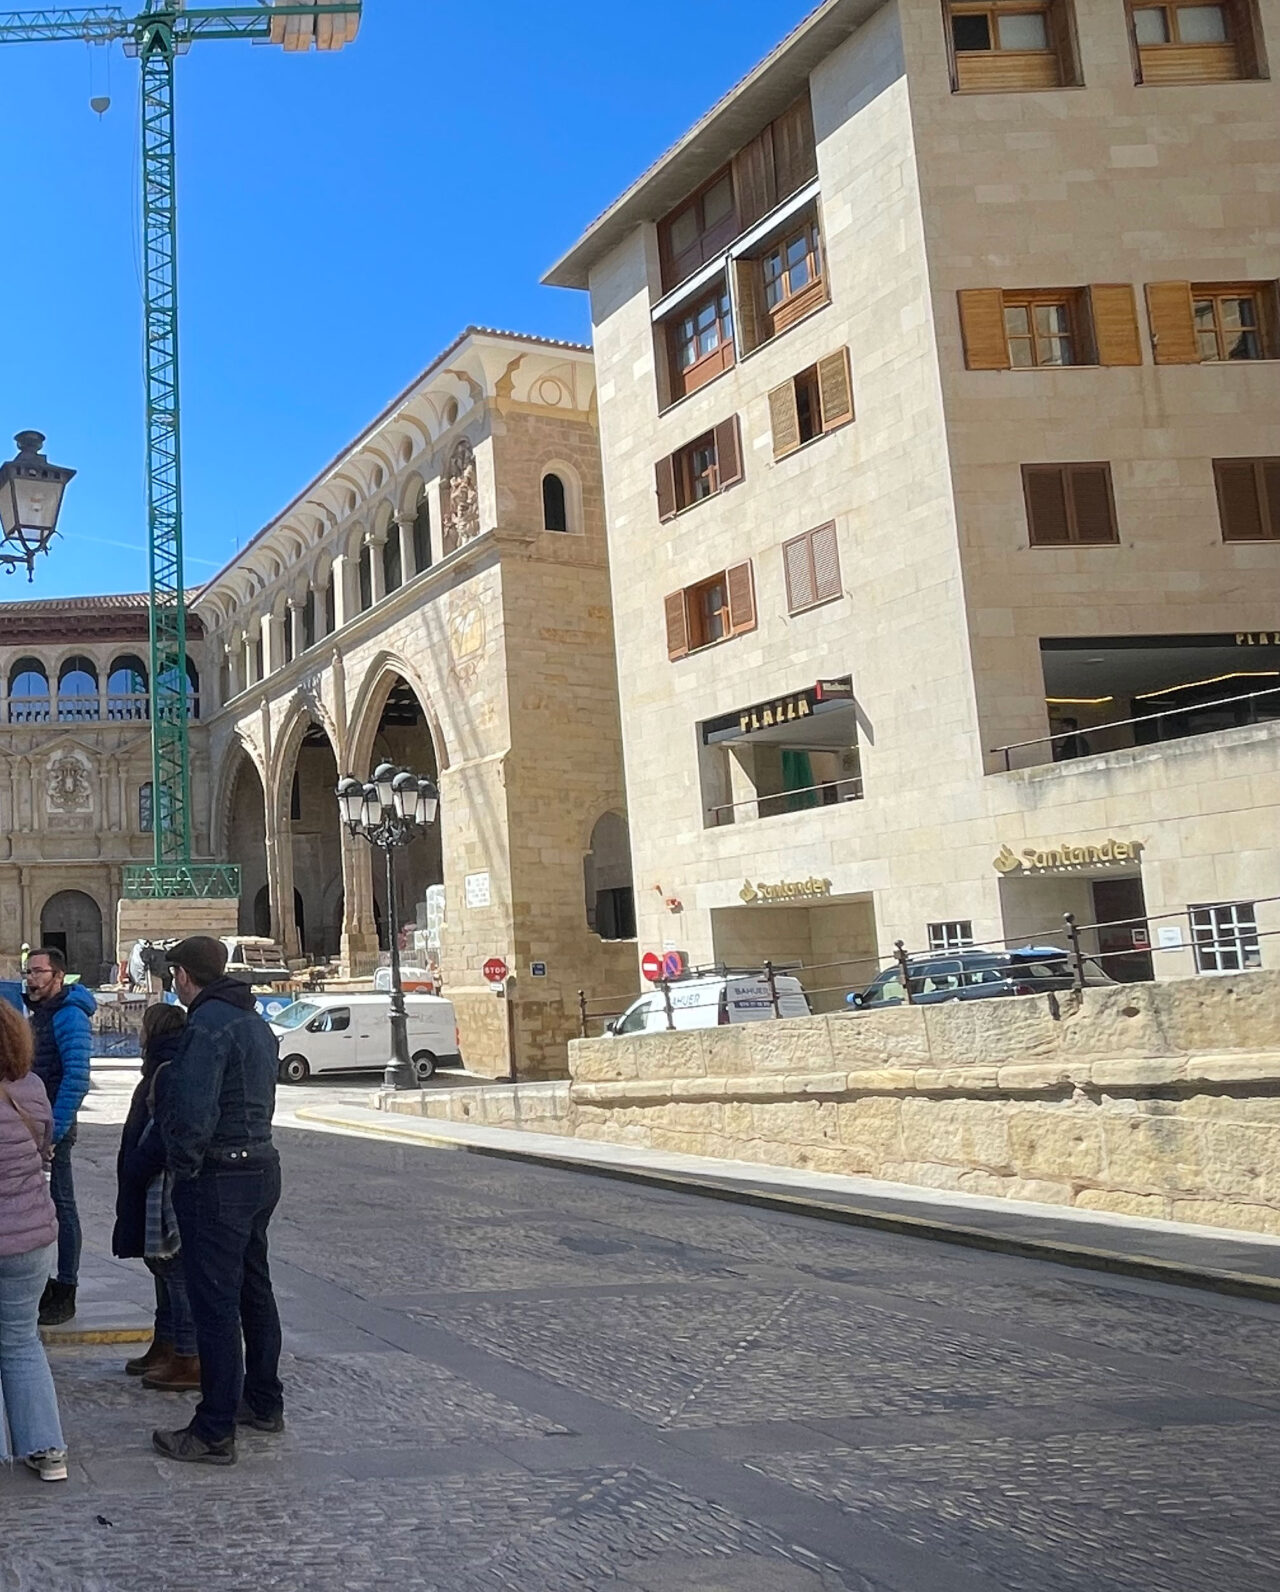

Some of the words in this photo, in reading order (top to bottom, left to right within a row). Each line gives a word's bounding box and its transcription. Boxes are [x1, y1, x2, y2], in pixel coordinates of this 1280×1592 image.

[1021, 838, 1144, 870] Santander
[757, 876, 832, 899] Santander
[484, 965, 506, 975] STOP
